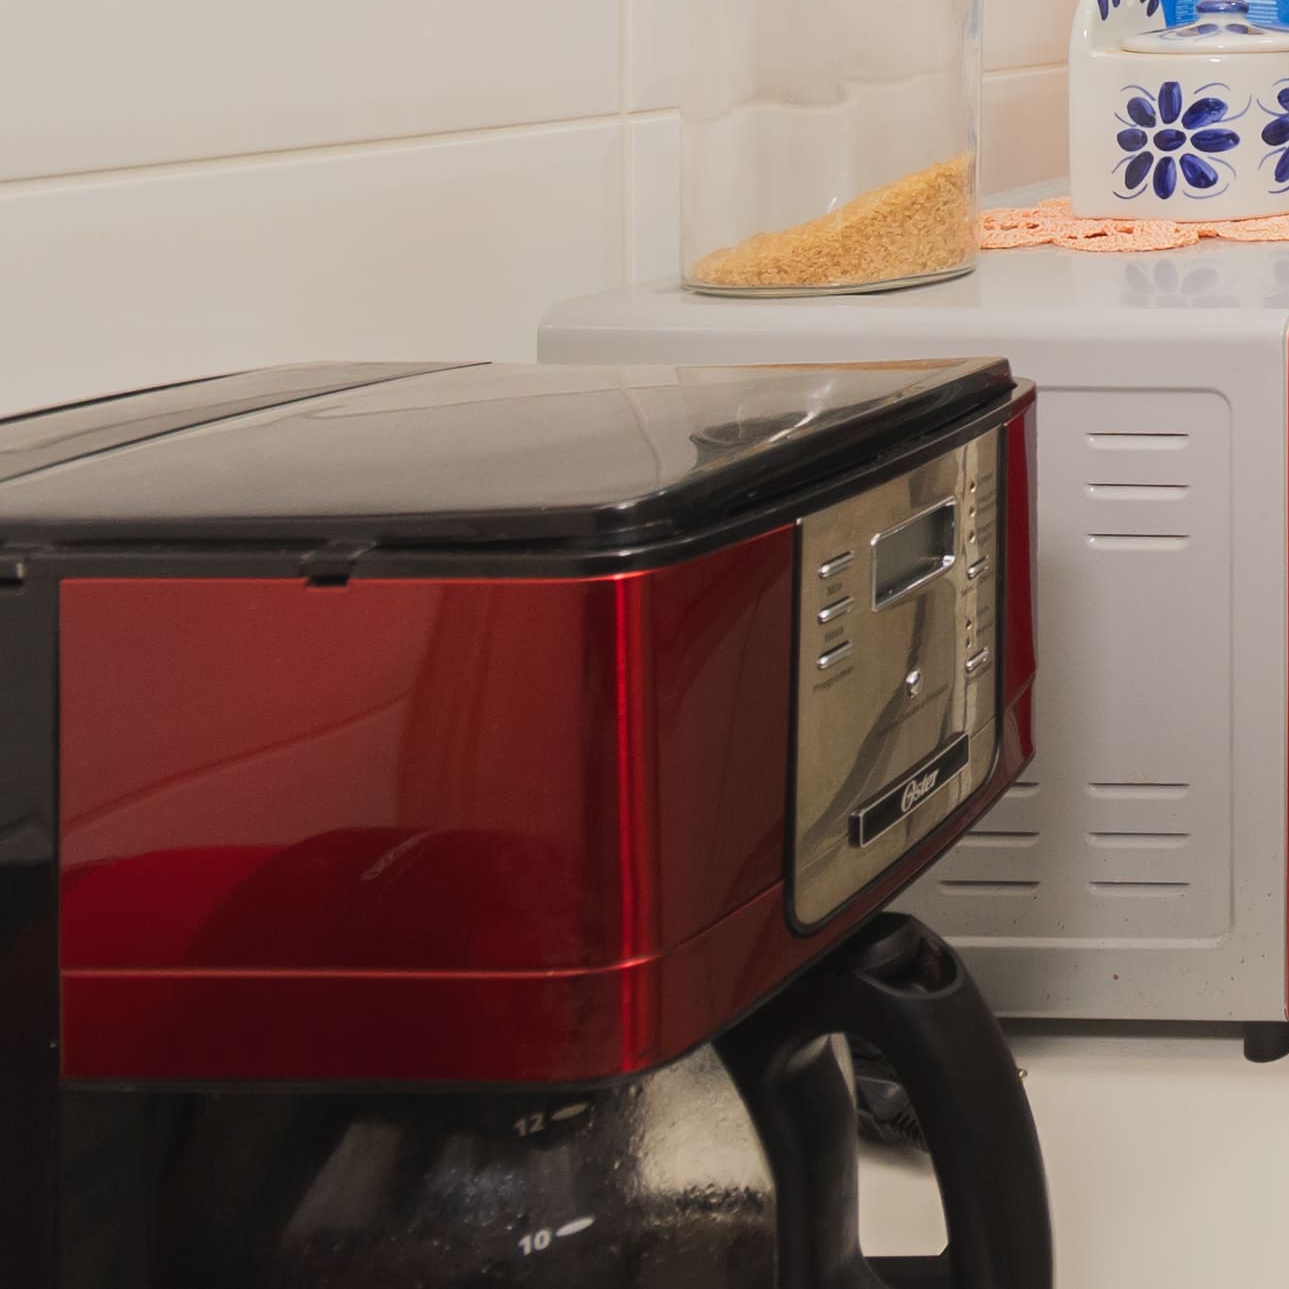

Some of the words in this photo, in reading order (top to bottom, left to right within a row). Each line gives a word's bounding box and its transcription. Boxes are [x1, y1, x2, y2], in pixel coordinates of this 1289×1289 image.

[902, 769, 940, 812] Oster
[514, 1112, 544, 1137] 12
[519, 1228, 551, 1255] 10
